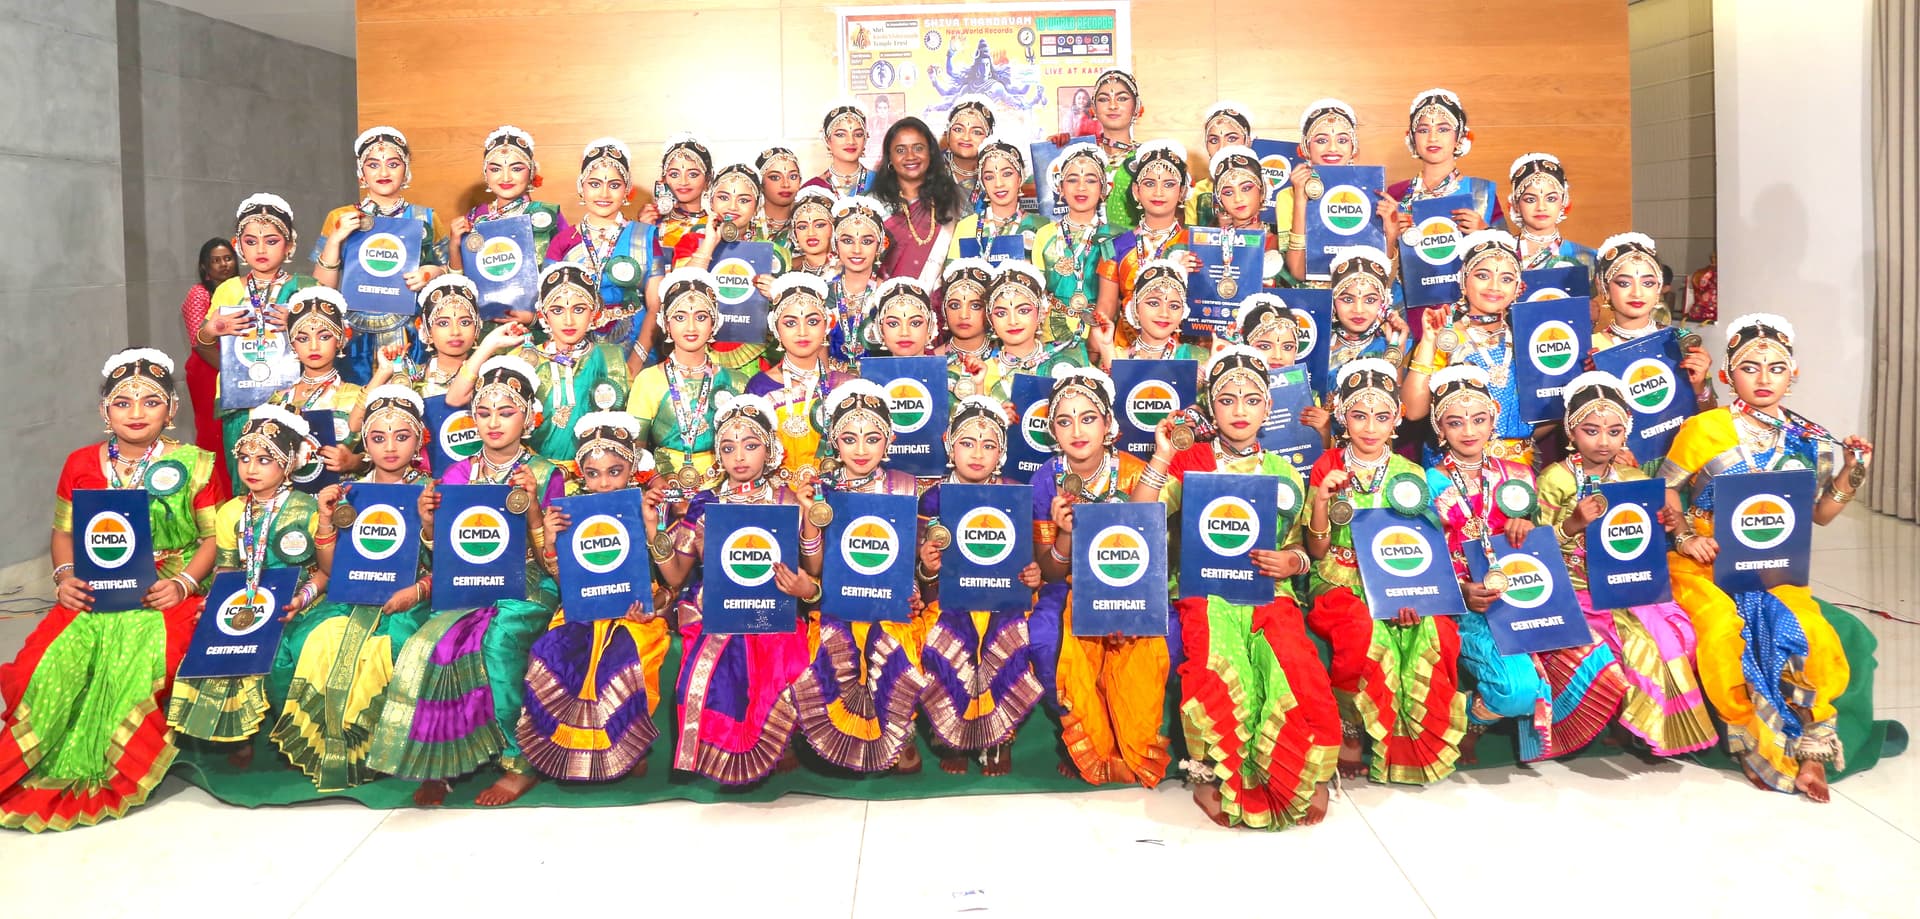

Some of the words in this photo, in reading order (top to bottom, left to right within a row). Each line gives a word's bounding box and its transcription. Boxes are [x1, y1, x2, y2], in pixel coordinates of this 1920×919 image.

[924, 18, 960, 28] SHIVA
[1045, 67, 1063, 75] LIVE
[1327, 205, 1363, 214] ICMDA
[365, 249, 399, 260] ICMDA
[482, 252, 516, 265] ICMDA
[1421, 273, 1458, 286] CERTIFICAT
[358, 284, 401, 296] CERTIFICATE
[1536, 342, 1571, 353] ICMDA
[1629, 375, 1668, 396] ICMDA
[1133, 401, 1172, 410] ICMDA
[447, 430, 477, 444] ICMD
[888, 445, 930, 454] ERTIFICATE
[1207, 520, 1250, 532] ICMDA
[1741, 515, 1785, 527] ICMDA
[359, 525, 397, 538] ICMDA
[458, 529, 500, 540] ICMDA
[964, 529, 1007, 541] ICMDA
[1608, 524, 1644, 538] ICMDA
[91, 534, 127, 544] ICMDA
[580, 538, 621, 551] ICMDA
[848, 538, 890, 551] ICMDA
[729, 550, 772, 562] ICMDA
[1097, 550, 1140, 561] ICMDA
[1380, 546, 1423, 557] ICMDA
[1735, 558, 1790, 571] CERTIFICATE
[349, 570, 396, 582] CERTIFICATE
[1201, 567, 1254, 581] CERTIFICATE
[1509, 573, 1543, 587] CMDA
[1607, 571, 1652, 585] CERTIFICATE
[88, 579, 137, 590] CERTIFICATE
[453, 576, 505, 586] CERTIFICATE
[959, 577, 1011, 588] CERTIFICATE
[581, 582, 631, 598] CERTIFICATE
[841, 585, 892, 599] CERTIFICATE
[1385, 586, 1440, 597] CERTIFICATE
[723, 599, 776, 609] CERTIFICATE
[1092, 599, 1146, 610] CERTIFICATE
[1510, 615, 1565, 632] CERTIFICATE
[206, 645, 258, 655] CERTIFICATE
